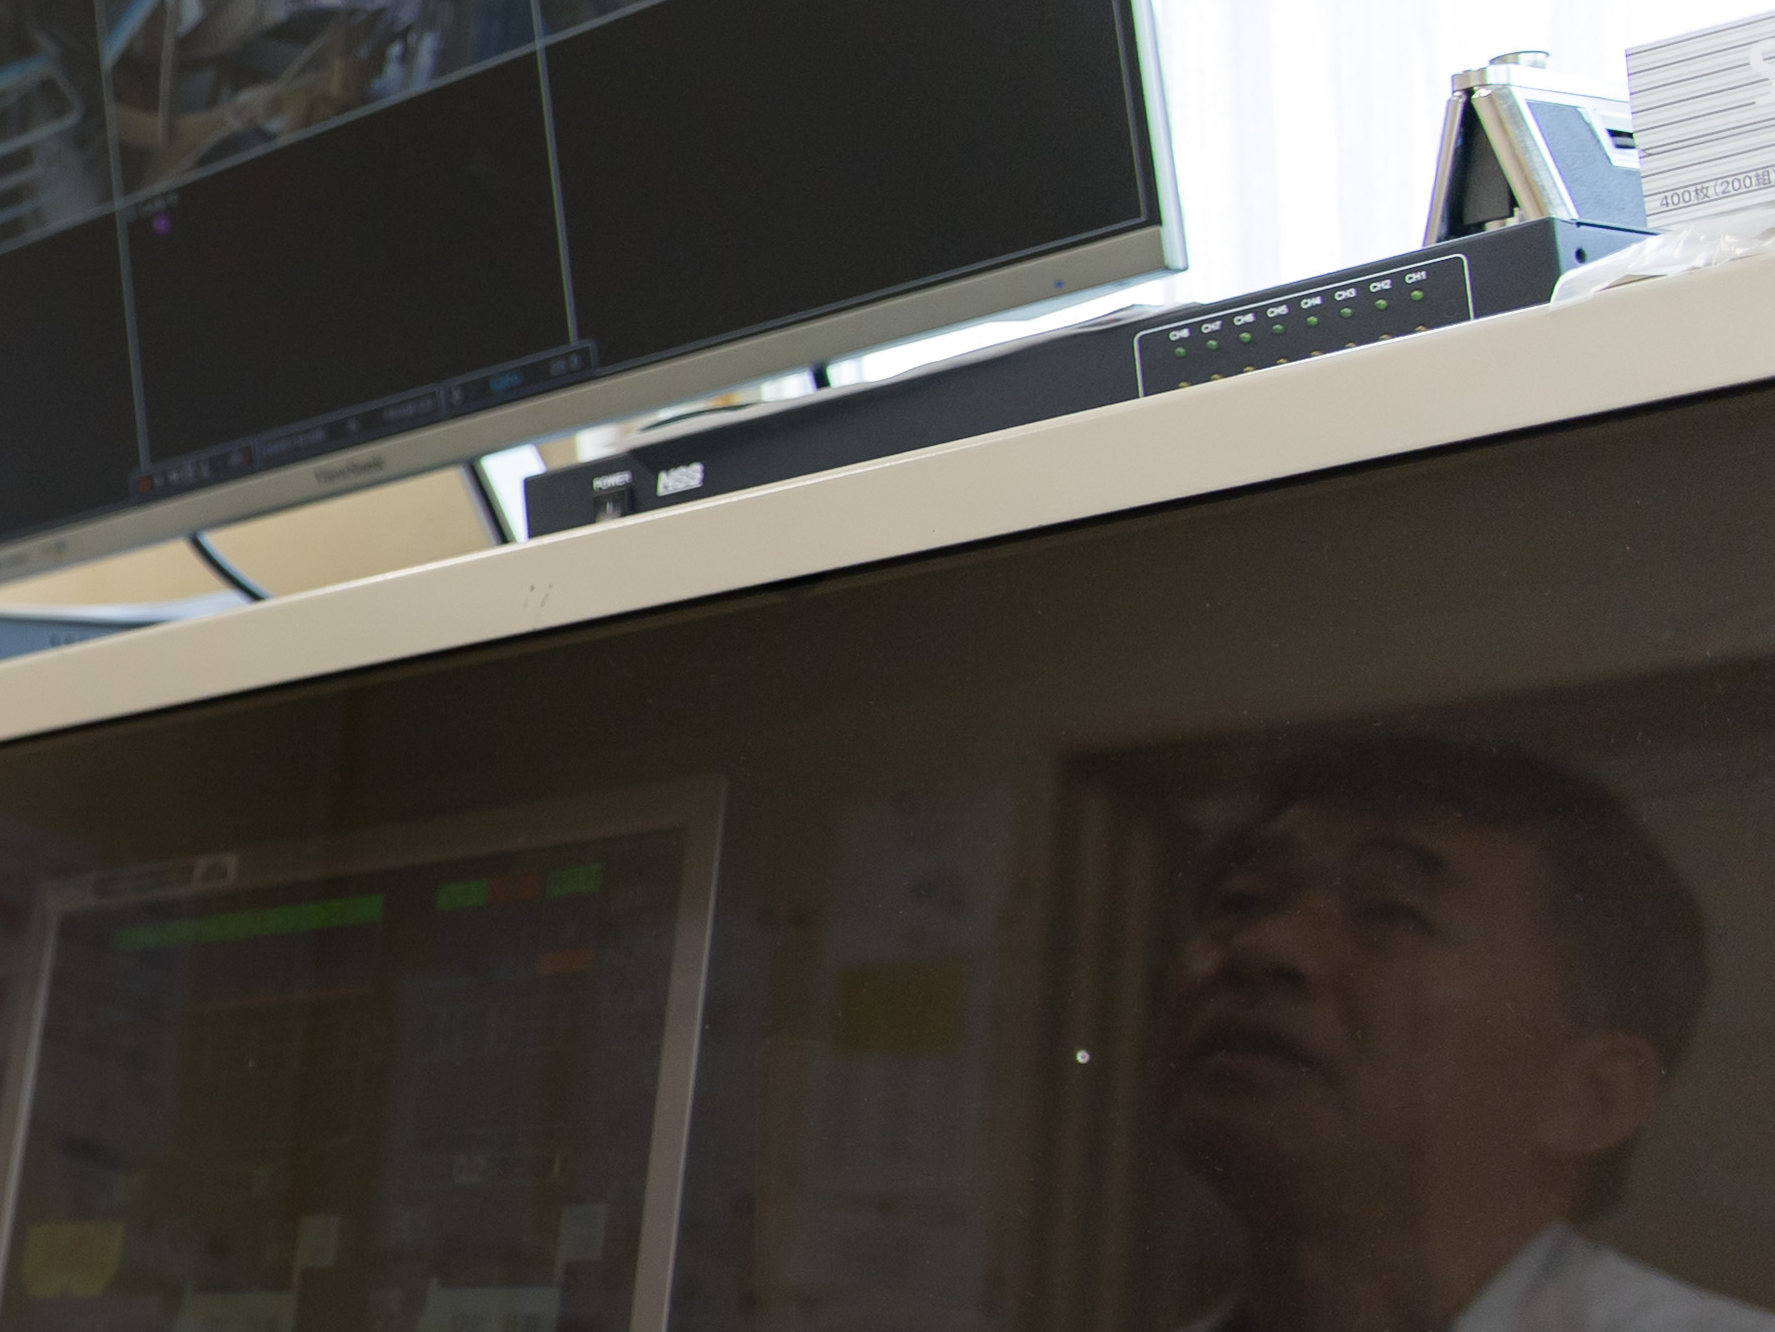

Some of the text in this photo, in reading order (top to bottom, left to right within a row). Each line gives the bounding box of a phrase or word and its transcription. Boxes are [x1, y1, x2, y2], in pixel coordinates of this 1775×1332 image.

[1201, 321, 1223, 334] CH7
[1266, 305, 1289, 318] CH5
[1300, 296, 1323, 309] CH4
[1334, 288, 1357, 301] CH3
[1369, 279, 1392, 293] CH2
[1405, 271, 1427, 284] CH1
[593, 470, 633, 491] POWER
